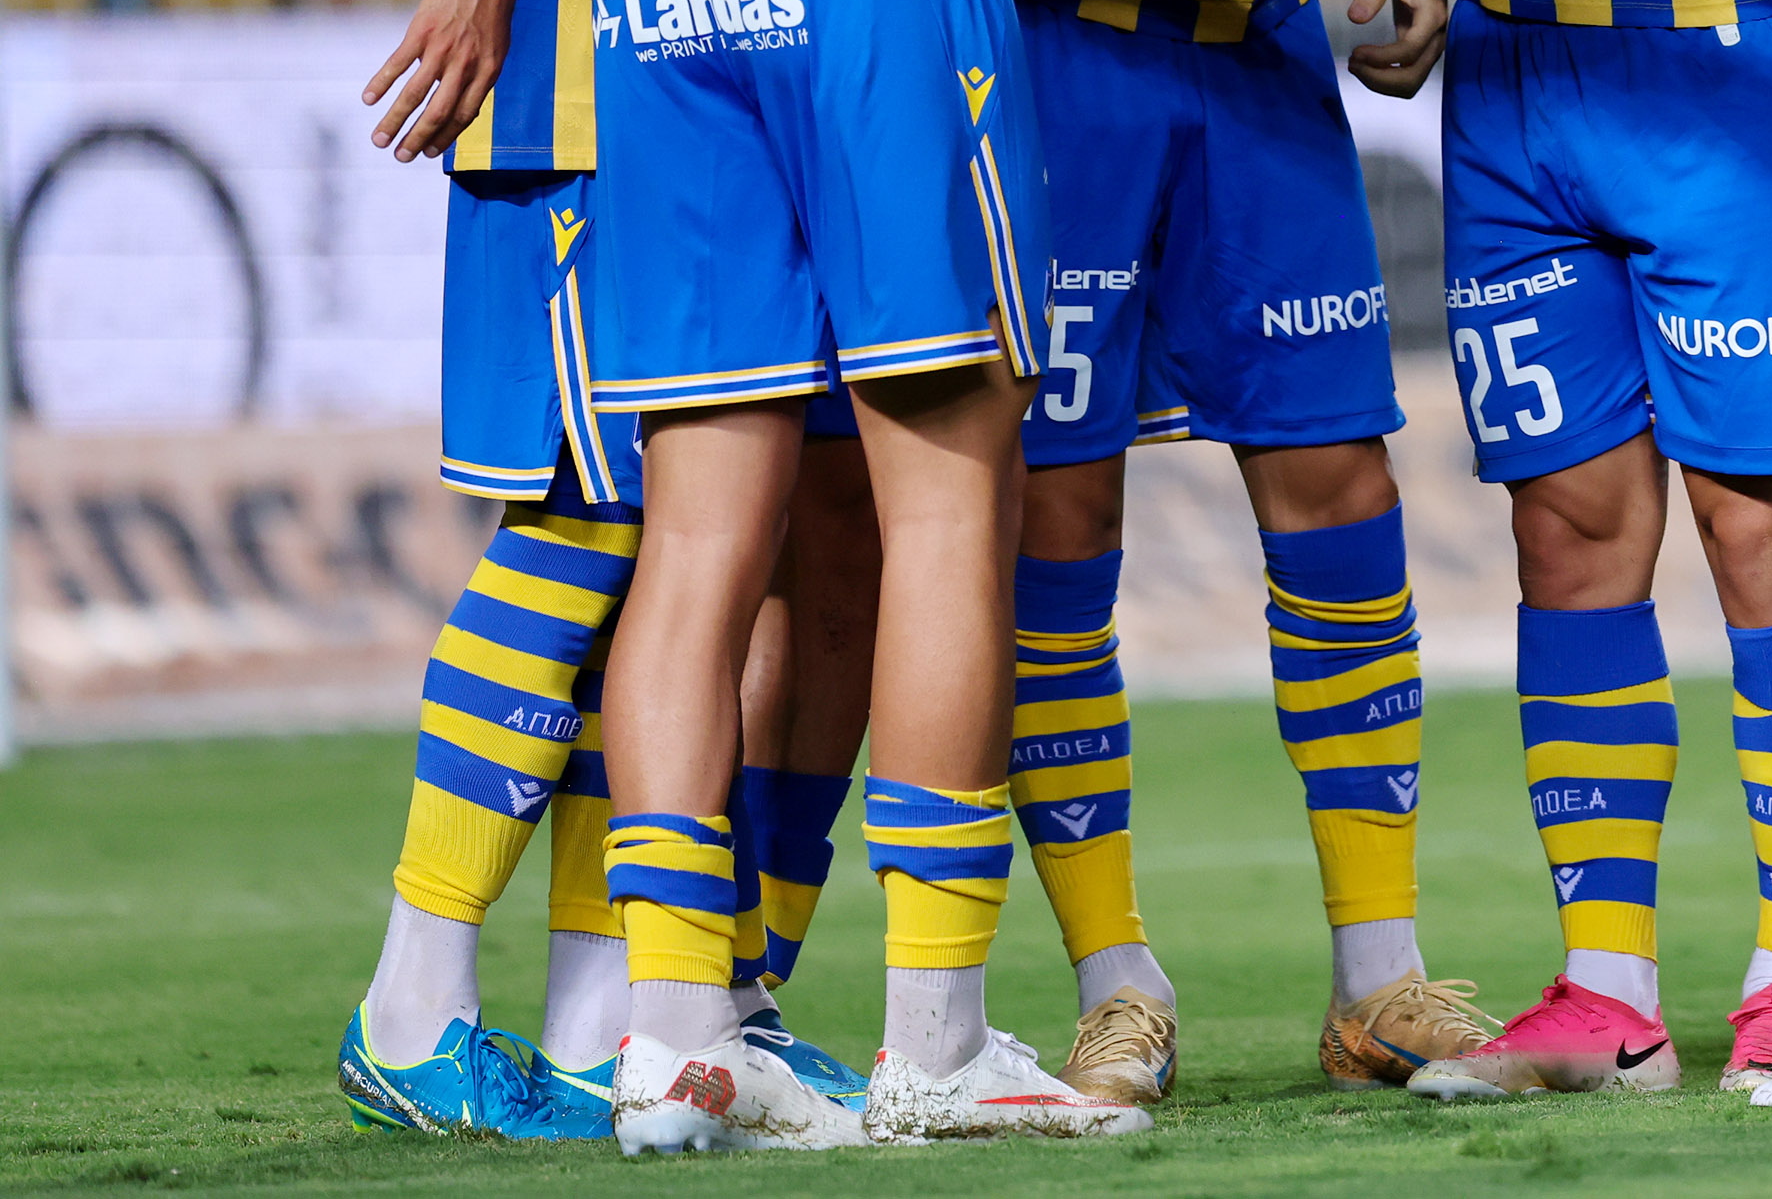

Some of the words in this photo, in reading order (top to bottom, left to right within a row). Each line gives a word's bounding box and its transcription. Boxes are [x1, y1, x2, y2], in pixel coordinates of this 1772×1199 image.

[635, 47, 658, 64] we
[661, 36, 714, 61] PRINT
[755, 30, 795, 51] SIGN
[1023, 305, 1094, 423] 5
[1455, 316, 1565, 443] 25
